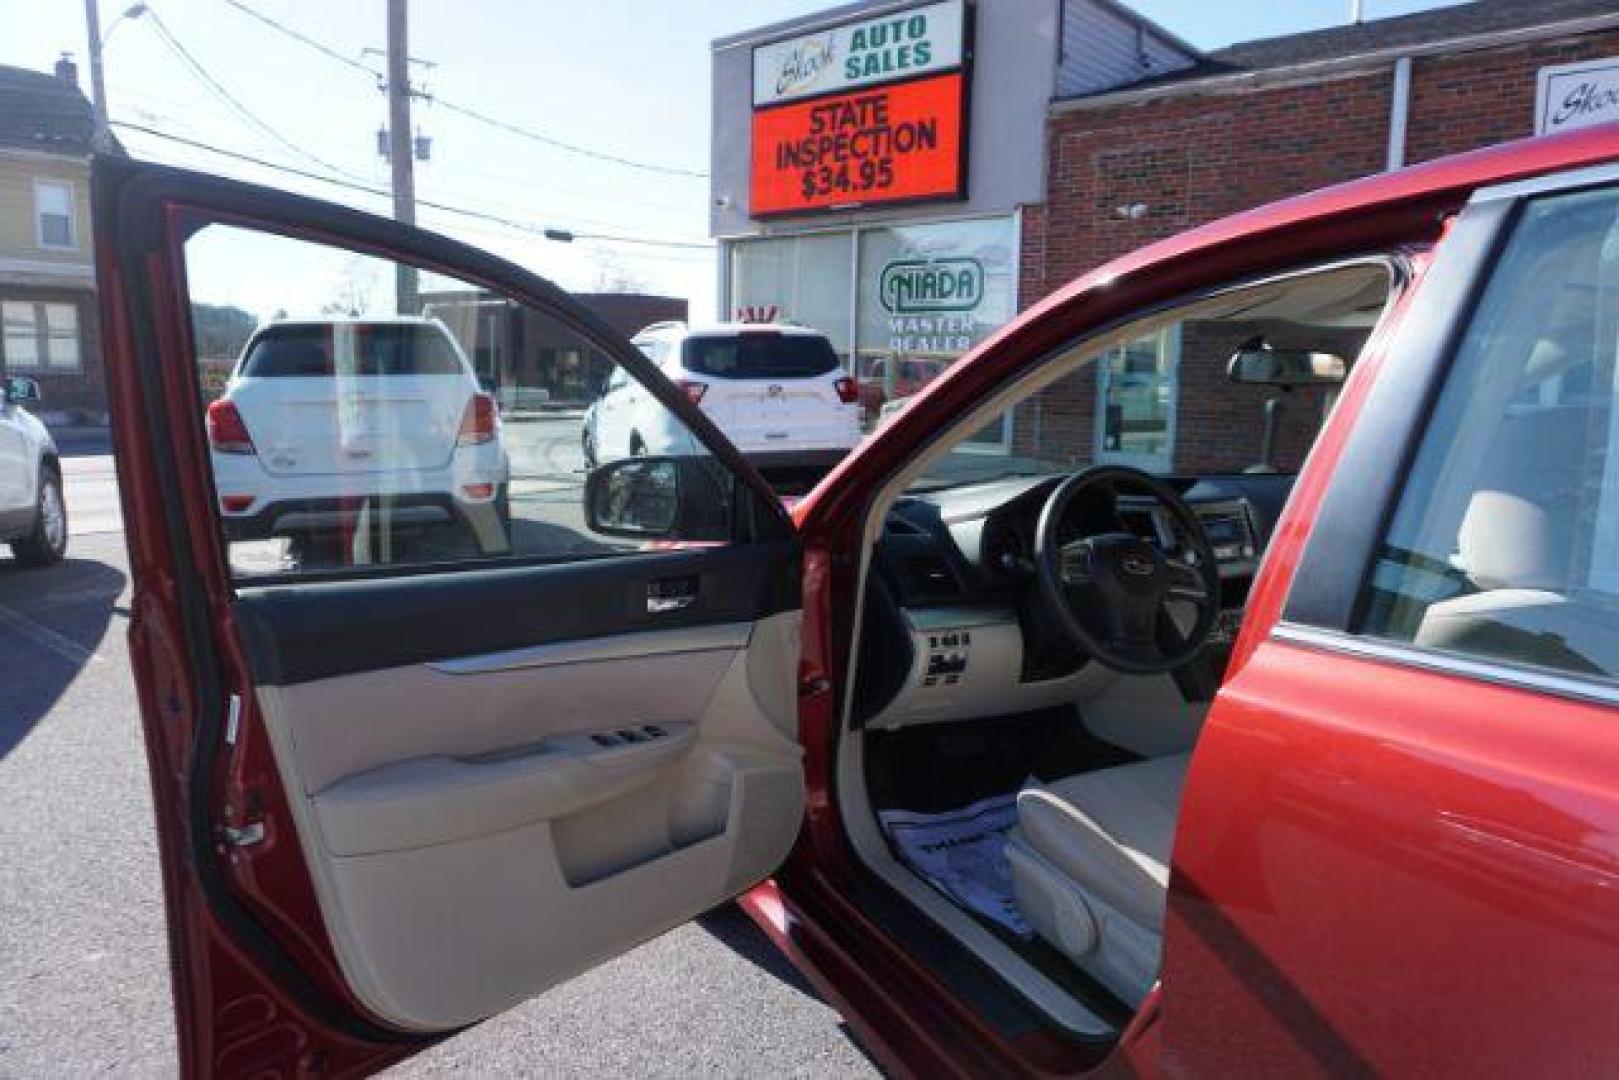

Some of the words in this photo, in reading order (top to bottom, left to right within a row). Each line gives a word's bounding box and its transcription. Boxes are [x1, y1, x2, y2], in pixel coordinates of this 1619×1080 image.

[850, 14, 927, 52] AUTO
[844, 40, 932, 80] SALES
[809, 94, 889, 135] STATE
[776, 117, 937, 170] INSPECTION
[802, 156, 893, 200] $34.95
[888, 268, 975, 312] NIADA
[889, 316, 972, 334] MASTER
[890, 335, 971, 353] DEALER
